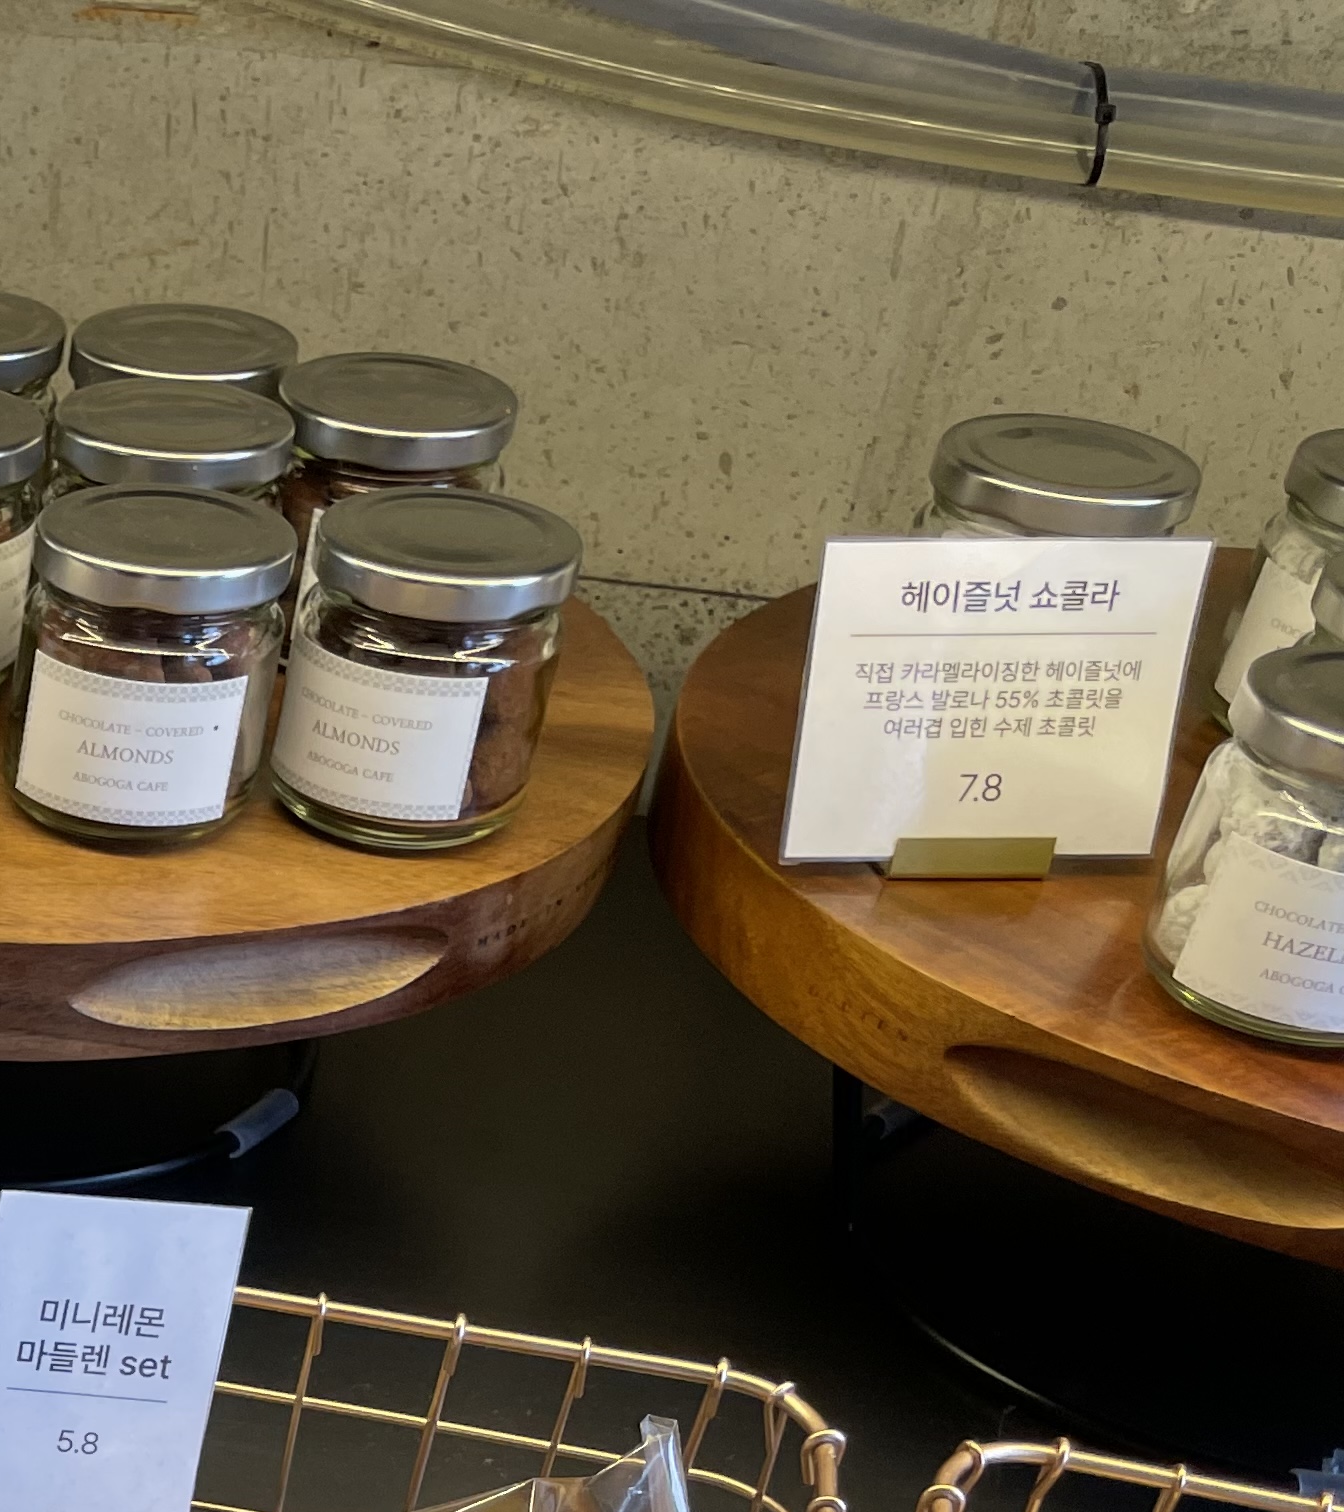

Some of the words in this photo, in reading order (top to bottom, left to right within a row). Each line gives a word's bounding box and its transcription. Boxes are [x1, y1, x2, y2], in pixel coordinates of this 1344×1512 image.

[901, 579, 1023, 615] 헤이즐넛
[1028, 579, 1121, 613] 쇼콜라
[854, 661, 895, 684] 직접
[899, 660, 1041, 684] 카라멜라이징한
[1044, 659, 1143, 683] 헤이즐넛에
[301, 686, 360, 720] CHOCOLATE
[372, 713, 433, 731] COVERED
[862, 690, 924, 711] 프랑스
[931, 688, 992, 711] 발로나
[995, 690, 1040, 709] 55%
[1044, 687, 1124, 711] 초콜릿을
[58, 708, 133, 736] CHOCOLATE
[145, 724, 204, 739] COVERED
[311, 719, 401, 756] ALMONDS
[883, 717, 943, 740] 여러겹
[949, 716, 987, 738] 입힌
[992, 716, 1033, 738] 수제
[1036, 716, 1096, 738] 초콜릿
[76, 739, 175, 766] ALMONDS
[306, 751, 359, 776] ABOGOGA
[362, 768, 395, 783] CAFE
[72, 770, 133, 792] ABOGOGA
[135, 779, 169, 794] CAFE
[957, 772, 1003, 803] 7.8
[1259, 968, 1335, 994] ABOGOGA
[39, 1299, 165, 1339] 미니레몬
[16, 1339, 111, 1376] 마들렌
[119, 1353, 172, 1380] set
[56, 1430, 100, 1455] 5.8
